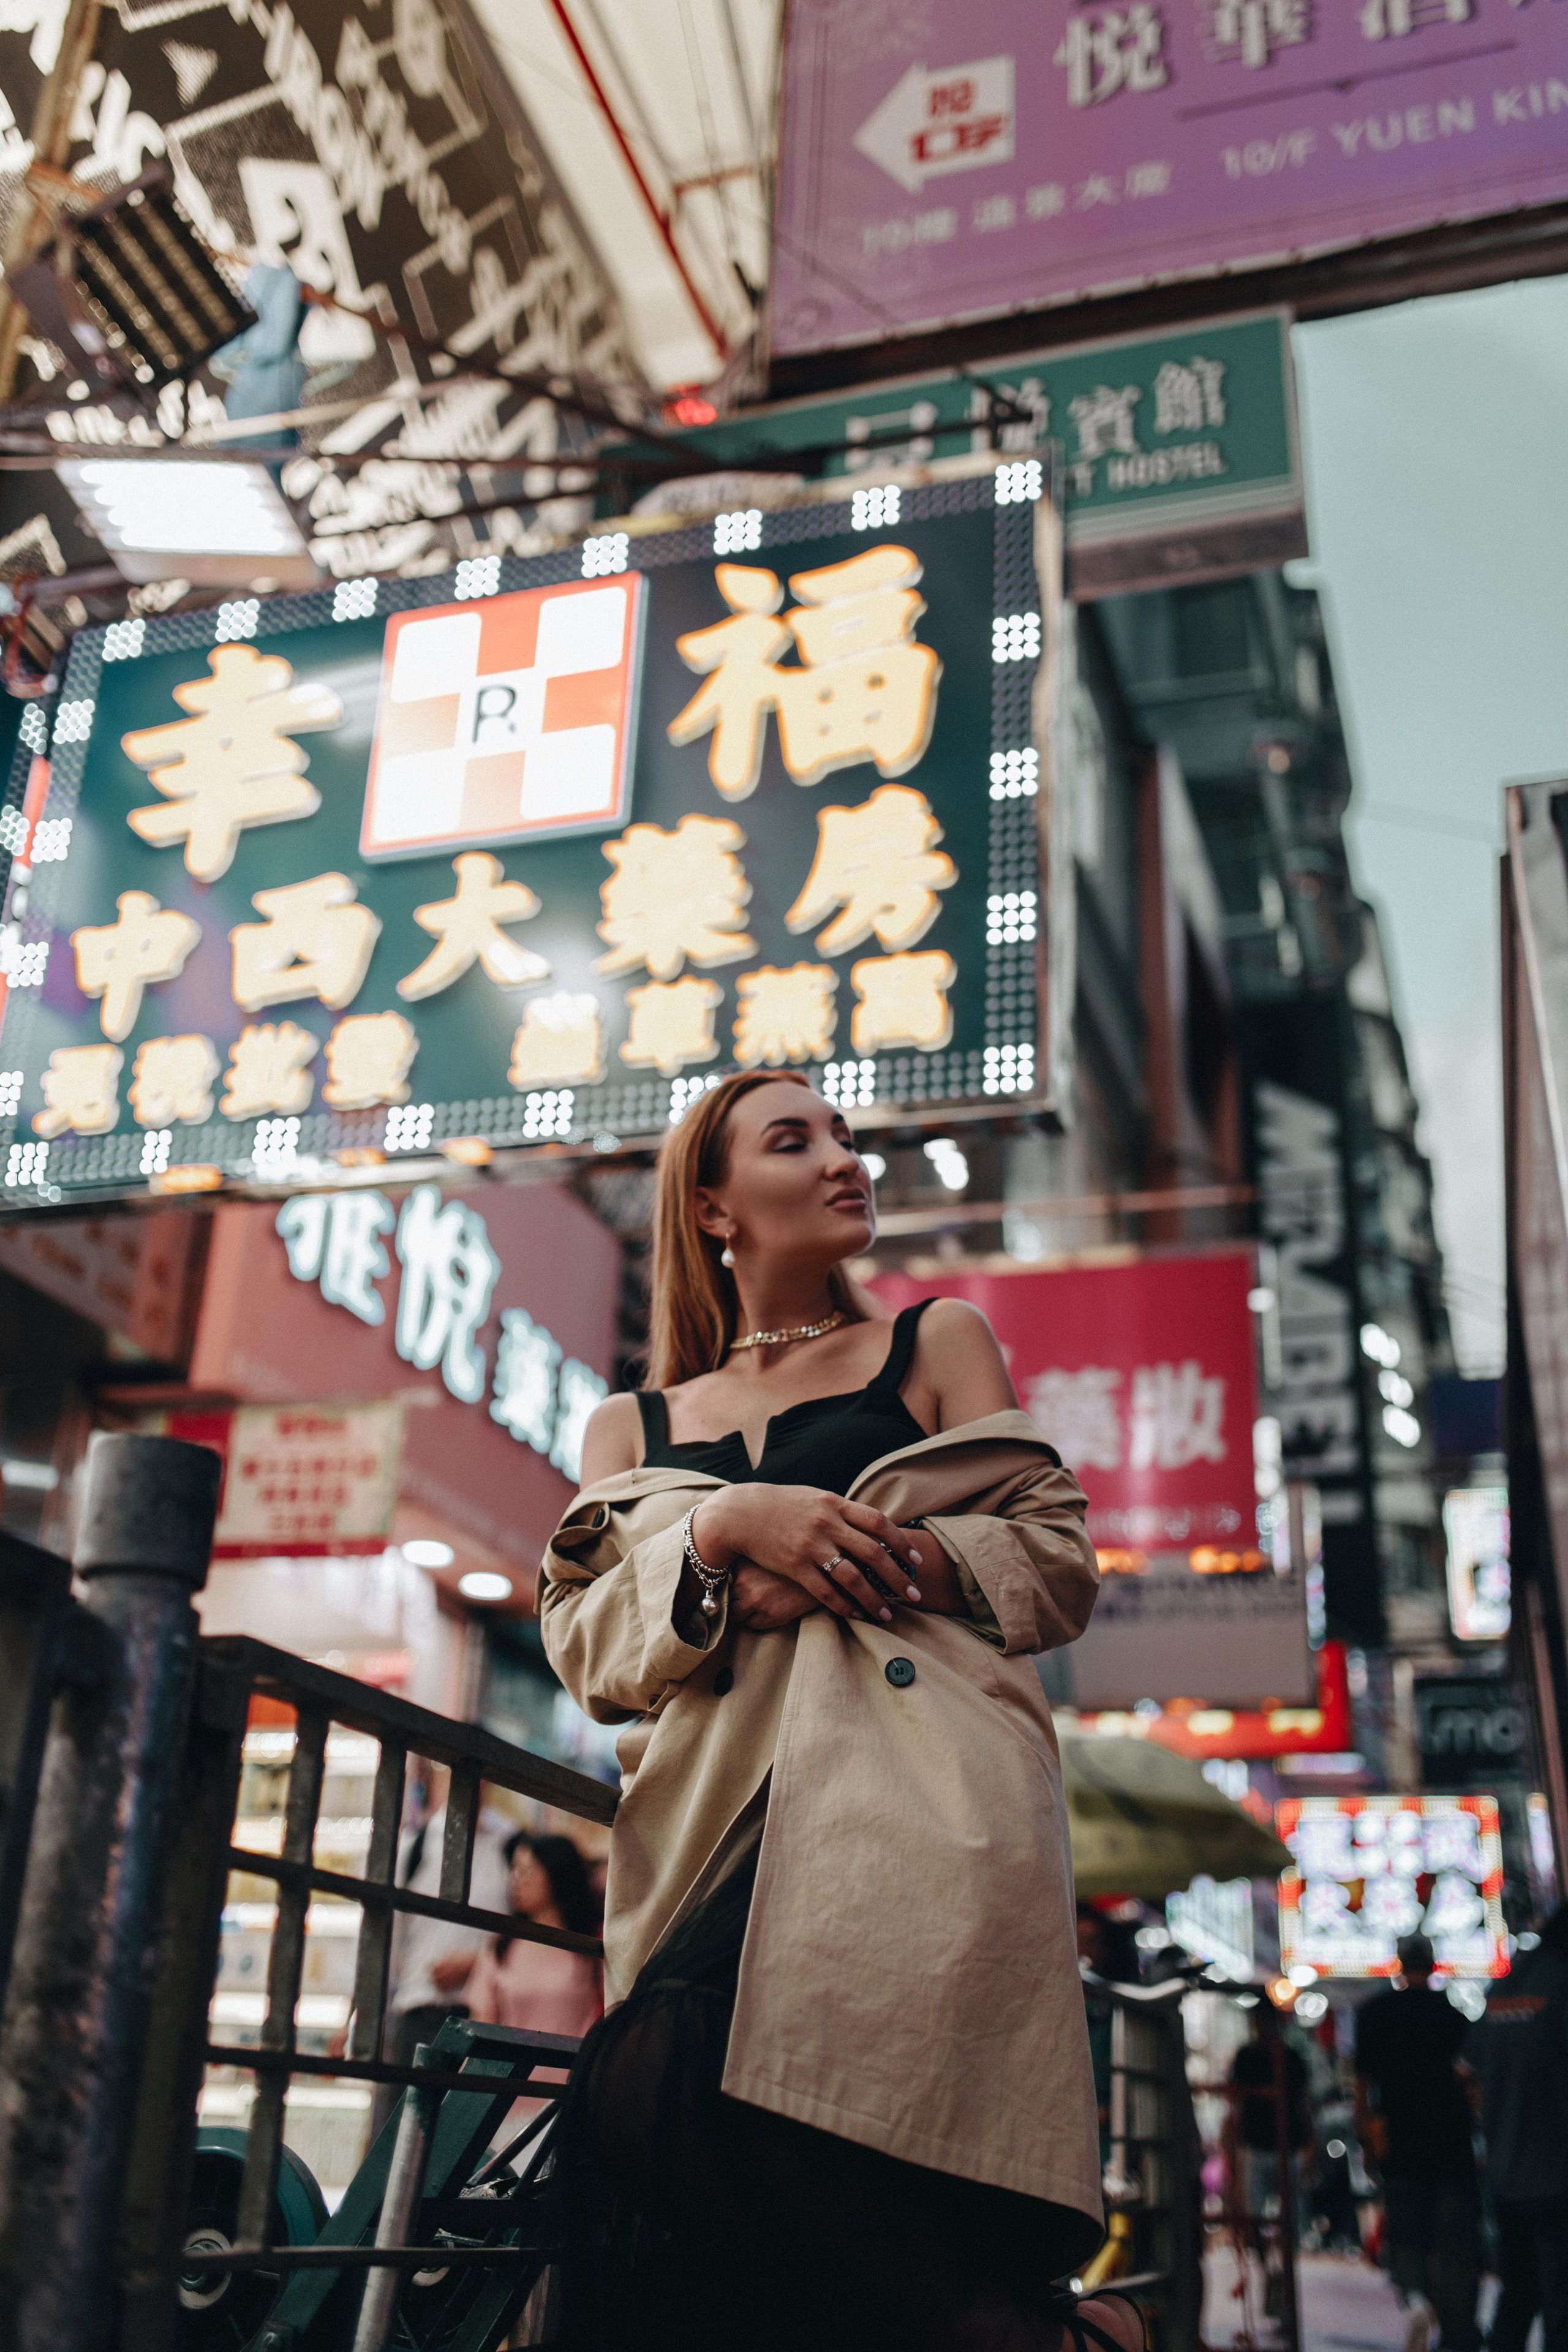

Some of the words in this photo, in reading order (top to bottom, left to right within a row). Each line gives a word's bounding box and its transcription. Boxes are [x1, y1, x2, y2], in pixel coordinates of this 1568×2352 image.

[1219, 127, 1317, 180] 10/F
[1328, 98, 1476, 158] YUEN
[1107, 440, 1227, 489] HOSTEL
